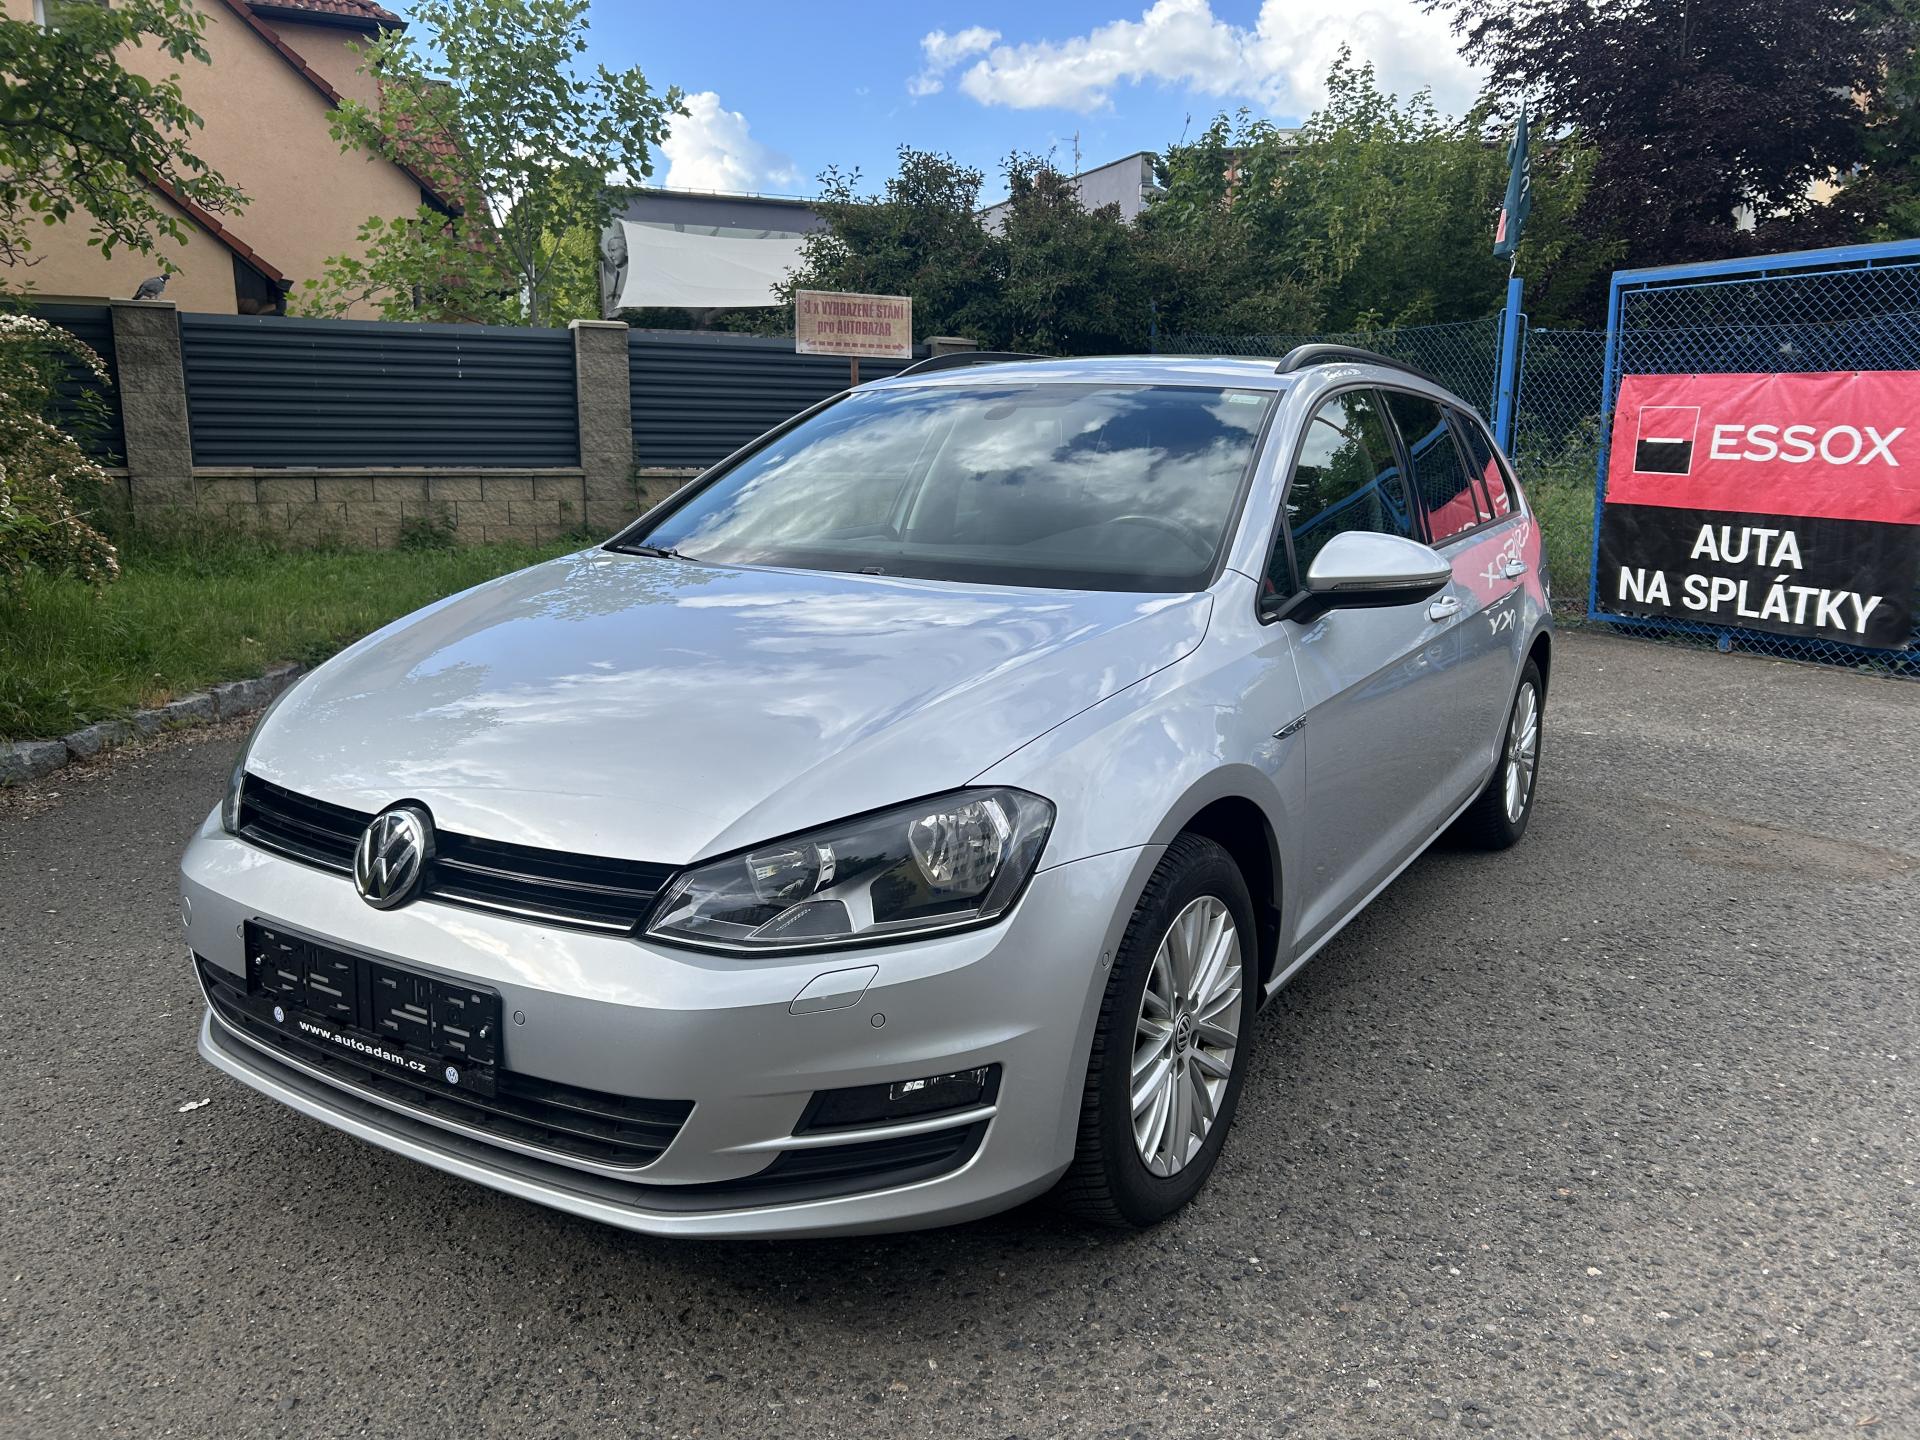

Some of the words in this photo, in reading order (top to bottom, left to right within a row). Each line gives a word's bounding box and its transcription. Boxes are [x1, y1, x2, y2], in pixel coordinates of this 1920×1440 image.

[804, 300, 811, 314] 3
[813, 302, 820, 314] x
[822, 301, 874, 319] VYHRAZENÉ
[817, 321, 835, 336] pro
[837, 320, 892, 337] AUTOBAZAR
[1709, 423, 1907, 467] ESSOX
[1690, 523, 1803, 570] AUTA
[1618, 565, 1671, 607] NA
[1682, 573, 1883, 634] SPLÁTKY
[298, 1020, 427, 1074] www.autoadam.cz
